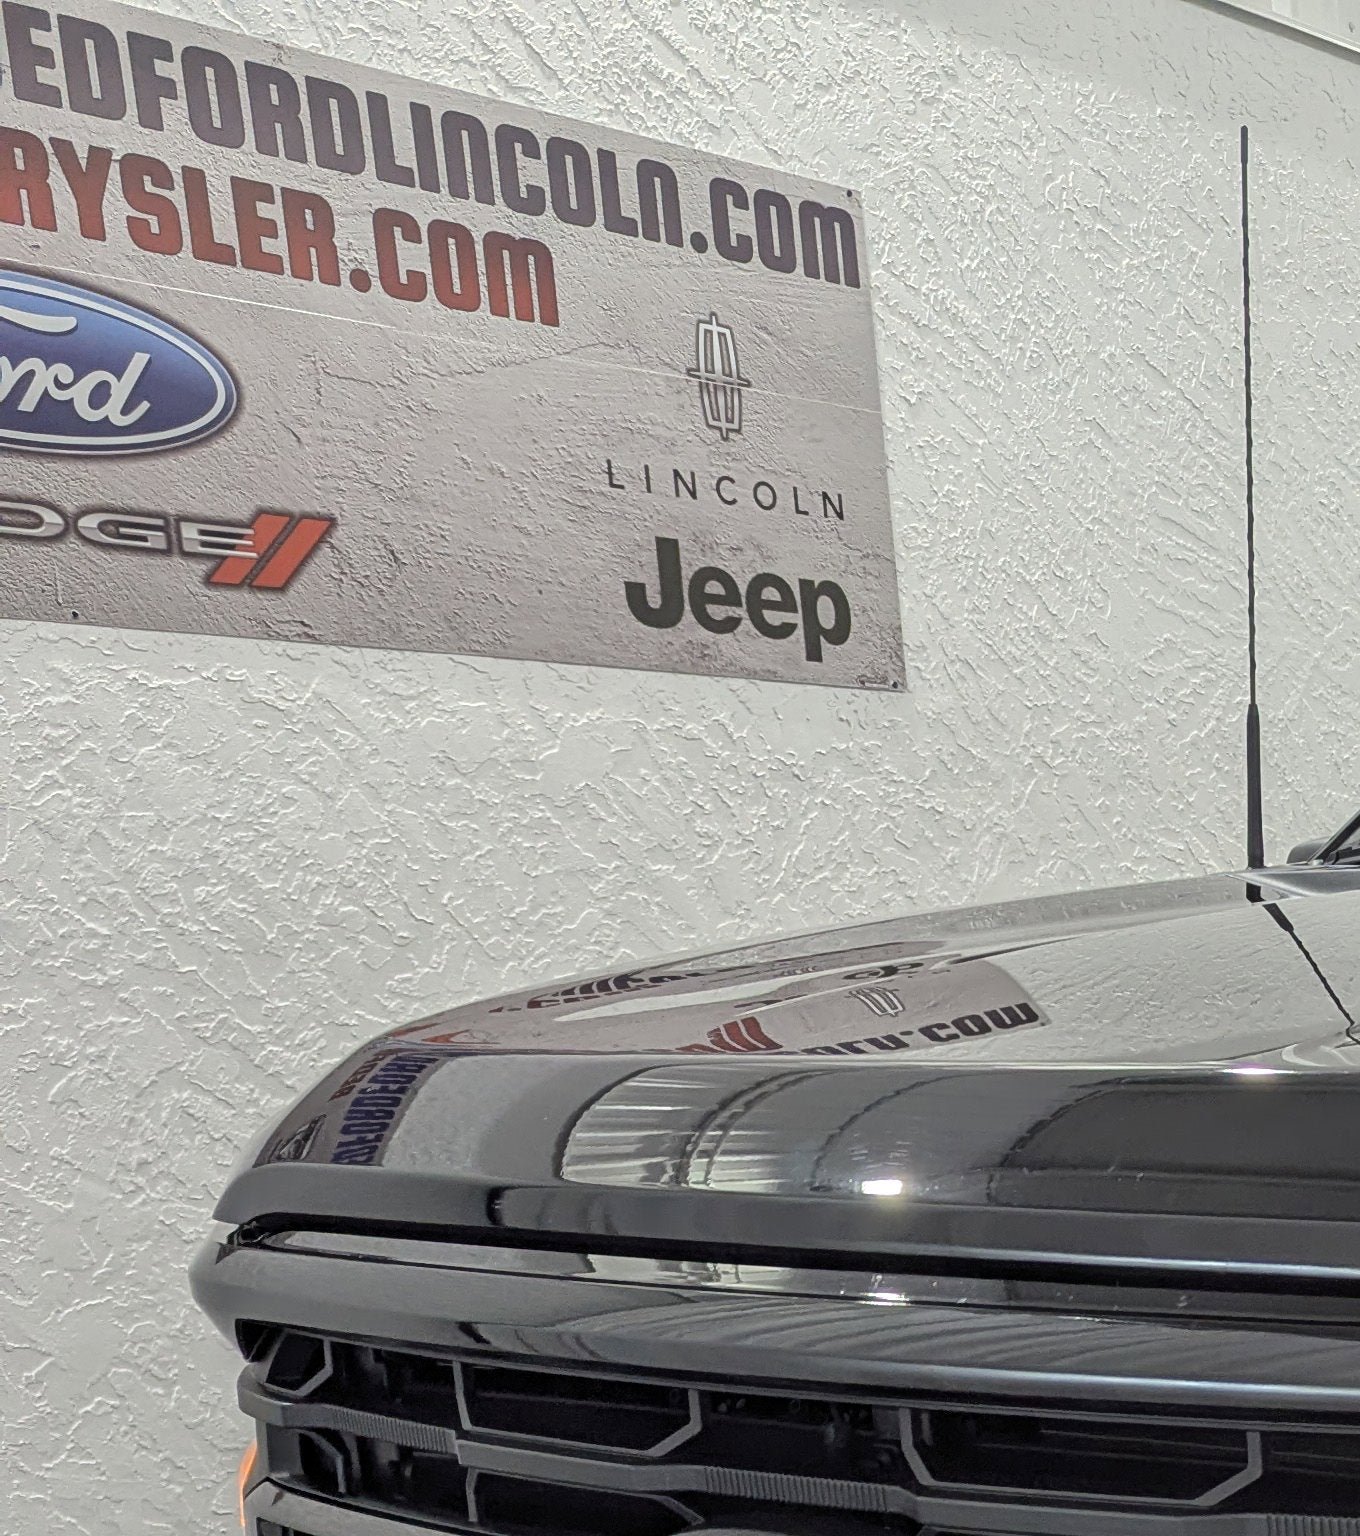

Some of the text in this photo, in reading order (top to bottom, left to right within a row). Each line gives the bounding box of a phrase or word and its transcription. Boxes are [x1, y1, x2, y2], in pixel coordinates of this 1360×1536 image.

[0, 1, 861, 289] EDFORDLINCOLN.COM
[606, 458, 845, 521] LINCOLN
[624, 535, 851, 663] Jeep
